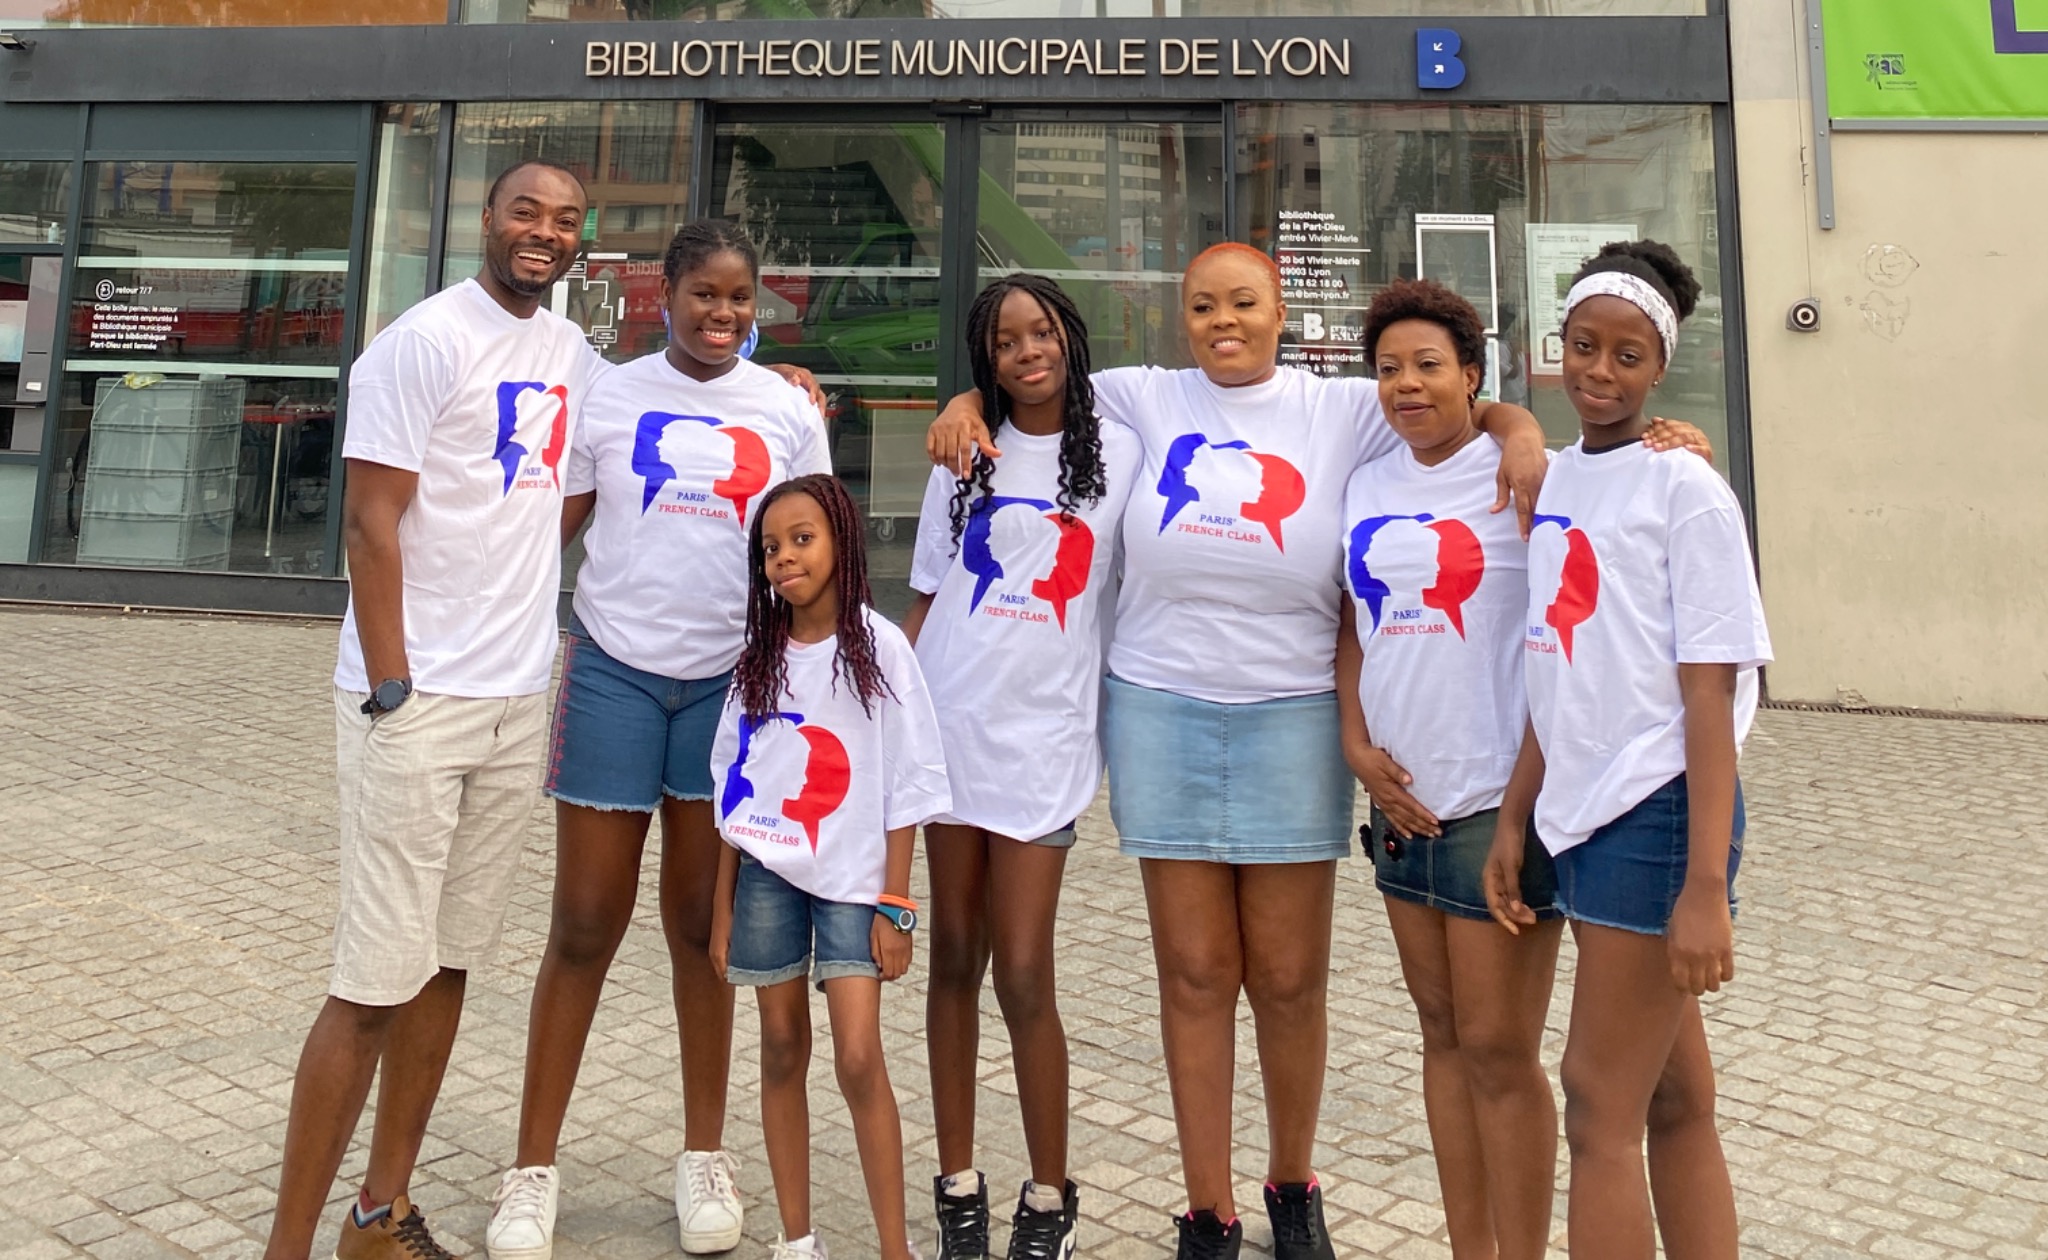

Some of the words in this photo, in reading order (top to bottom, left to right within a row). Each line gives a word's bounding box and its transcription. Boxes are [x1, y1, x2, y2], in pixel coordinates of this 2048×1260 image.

[585, 39, 880, 77] BIBLIOTHEQUE
[891, 37, 1146, 76] MUNICIPALE
[1159, 38, 1220, 76] DE
[1232, 37, 1350, 76] LYON
[1279, 210, 1335, 221] bibliothèque
[1279, 222, 1291, 230] de
[1293, 222, 1301, 231] la
[1303, 222, 1345, 232] Part-Dieu
[1279, 233, 1306, 242] entrée
[1308, 234, 1359, 243] Vivier-Merle
[1280, 256, 1291, 264] 30
[1292, 256, 1304, 264] bd
[1306, 256, 1360, 265] Vivier-Merle
[1280, 267, 1306, 276] 69003
[1308, 267, 1331, 278] Lyon
[1280, 279, 1291, 287] 04
[1293, 279, 1304, 287] 78
[1306, 279, 1317, 287] 62
[1319, 279, 1330, 287] 18
[115, 286, 138, 294] retour
[138, 286, 153, 294] 7/7
[1280, 290, 1350, 301] bm@bm-lyon.fr
[99, 322, 137, 331] Bibliothèque
[138, 324, 172, 332] municipale
[125, 332, 167, 342] bibliothèque
[1281, 352, 1308, 360] mardi
[1309, 353, 1321, 361] au
[1323, 353, 1363, 362] vendredi
[1296, 364, 1312, 372] 10h
[1314, 364, 1320, 373] à
[1322, 364, 1339, 374] 19h
[658, 504, 697, 515] FRENCH
[700, 507, 729, 519] CLASS
[1177, 524, 1223, 537] FRENCH
[1227, 531, 1262, 543] CLASS
[983, 606, 1017, 619] FRENCH
[1019, 611, 1049, 623] CLASS
[1380, 625, 1415, 636] FRENCH
[1418, 624, 1446, 634] CLASS
[728, 824, 768, 840] FRENCH
[769, 832, 800, 847] CLASS
